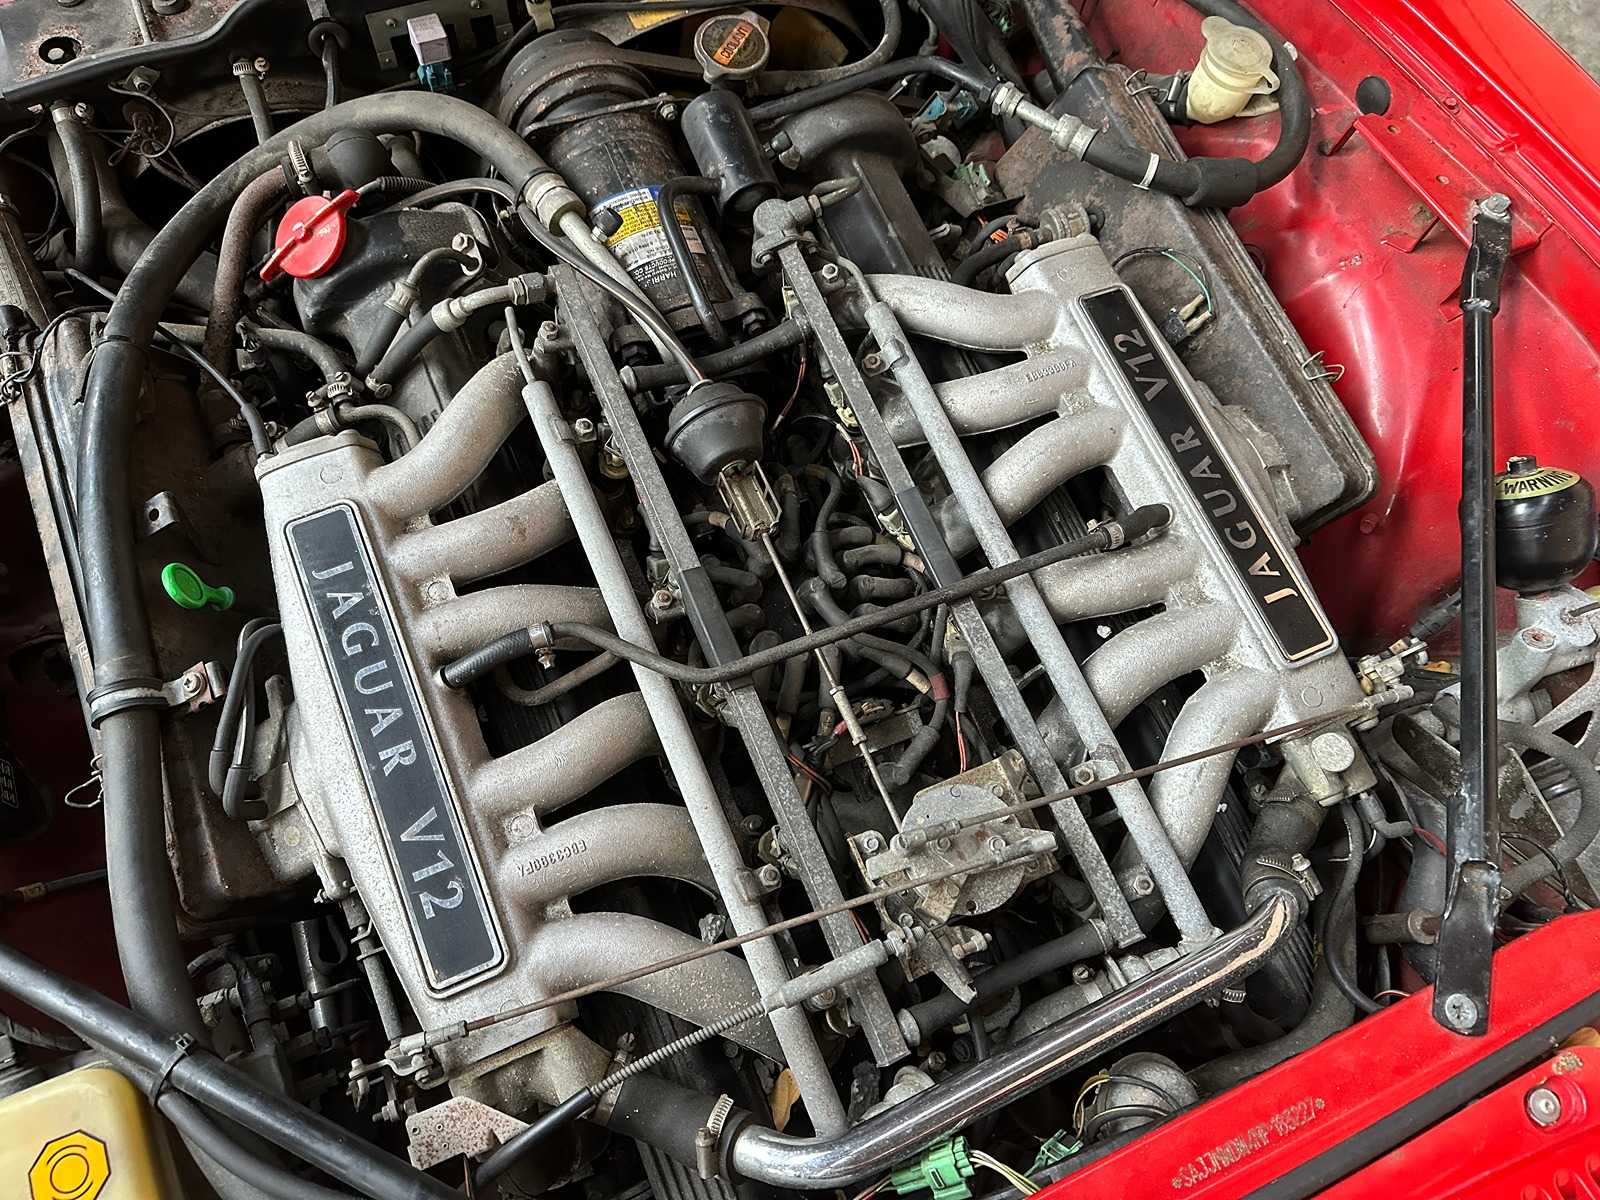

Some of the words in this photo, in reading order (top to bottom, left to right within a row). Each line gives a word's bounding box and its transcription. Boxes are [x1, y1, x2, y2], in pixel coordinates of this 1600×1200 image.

[1113, 328, 1169, 401] V12
[1169, 425, 1299, 605] JAGUAR
[1503, 470, 1573, 495] WARNING
[311, 561, 418, 777] JAGUAR
[400, 806, 464, 919] V12
